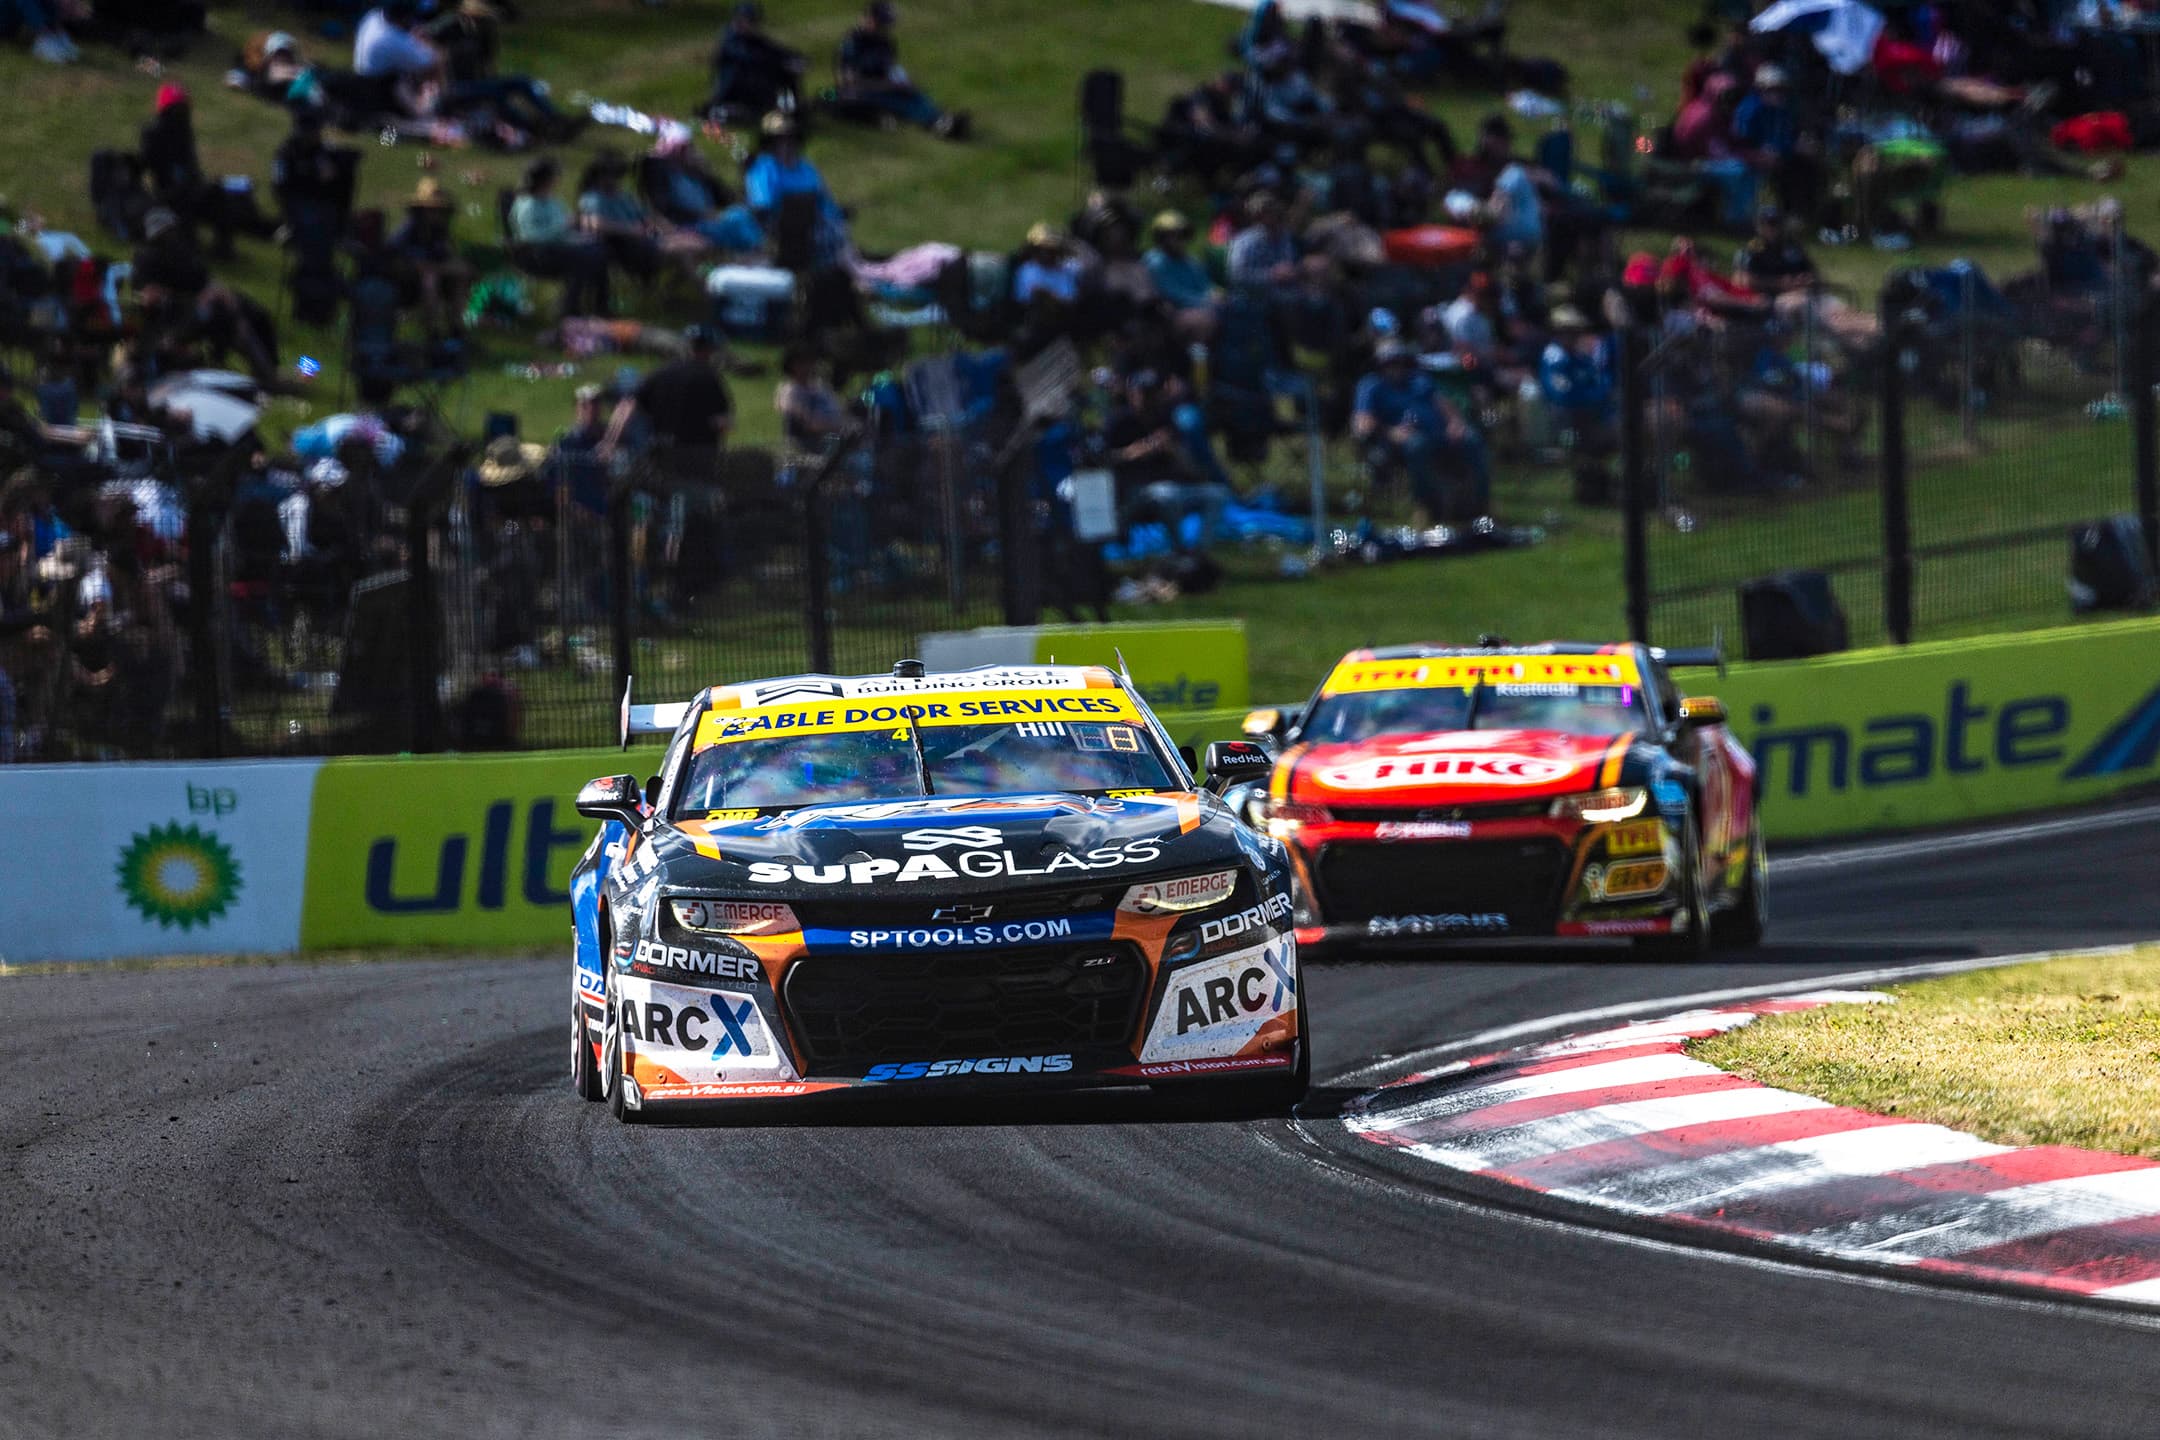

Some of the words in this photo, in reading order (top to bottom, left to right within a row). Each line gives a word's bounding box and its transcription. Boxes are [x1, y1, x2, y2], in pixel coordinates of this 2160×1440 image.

[857, 682, 975, 694] BUILDING
[982, 678, 1069, 688] GROUP
[751, 710, 835, 731] ABLE
[845, 703, 952, 724] DOOR
[960, 697, 1121, 717] SERVICES
[892, 728, 910, 742] 4
[1015, 721, 1067, 737] Hill
[1222, 755, 1245, 764] Red
[1246, 754, 1266, 764] Hat
[186, 780, 237, 817] bp
[365, 796, 584, 916] ult
[1167, 873, 1229, 898] EMERGE
[713, 903, 785, 921] EMERGE
[1200, 892, 1294, 944] DORMER
[850, 918, 1072, 948] SPTOOLS.COM
[635, 939, 760, 981] DORMER
